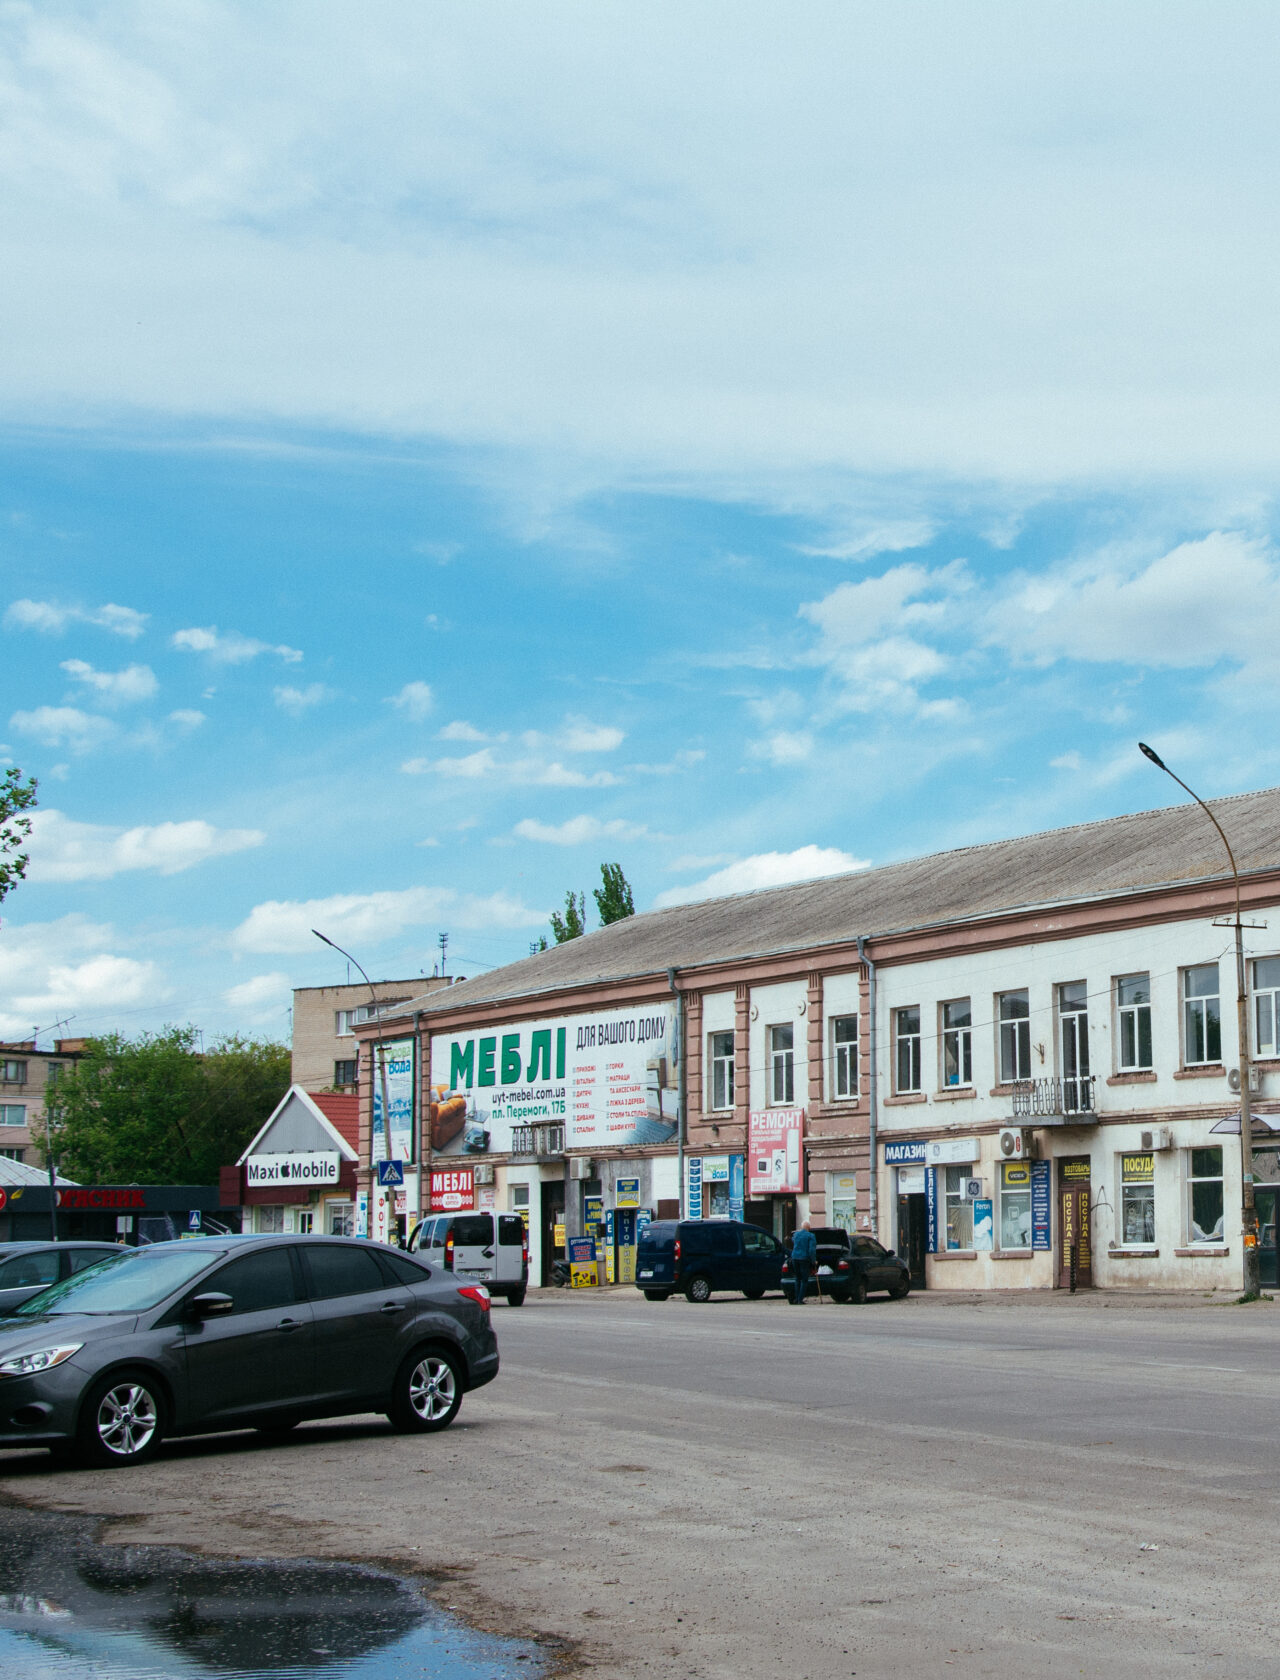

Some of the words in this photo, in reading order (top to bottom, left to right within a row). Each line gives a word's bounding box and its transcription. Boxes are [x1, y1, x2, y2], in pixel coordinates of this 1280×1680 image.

[576, 1025, 596, 1051] ДЛЯ
[598, 1019, 636, 1046] ВАШОГО
[637, 1016, 666, 1044] ДОМУ
[450, 1027, 566, 1090] МЕБЛІ
[492, 1087, 566, 1106] uyt-mebel.com.ua
[628, 1097, 645, 1105] ДЕРЕВА
[492, 1109, 505, 1119] пл.
[507, 1105, 550, 1120] Перемоги,
[552, 1101, 566, 1114] 17Б
[751, 1111, 802, 1130] РЕМОНТ
[886, 1144, 927, 1160] МАГАЗИН
[249, 1164, 279, 1180] Maxi
[291, 1161, 336, 1178] Mobile
[1123, 1156, 1155, 1173] ПОСУДА
[432, 1172, 472, 1192] МЕБЛІ
[927, 1168, 935, 1252] ЕЛЕКТРИКА
[1065, 1193, 1073, 1238] ПОСУДА
[1081, 1192, 1089, 1238] ПОСУДА
[623, 1210, 631, 1281] ОПТОВИЧОК
